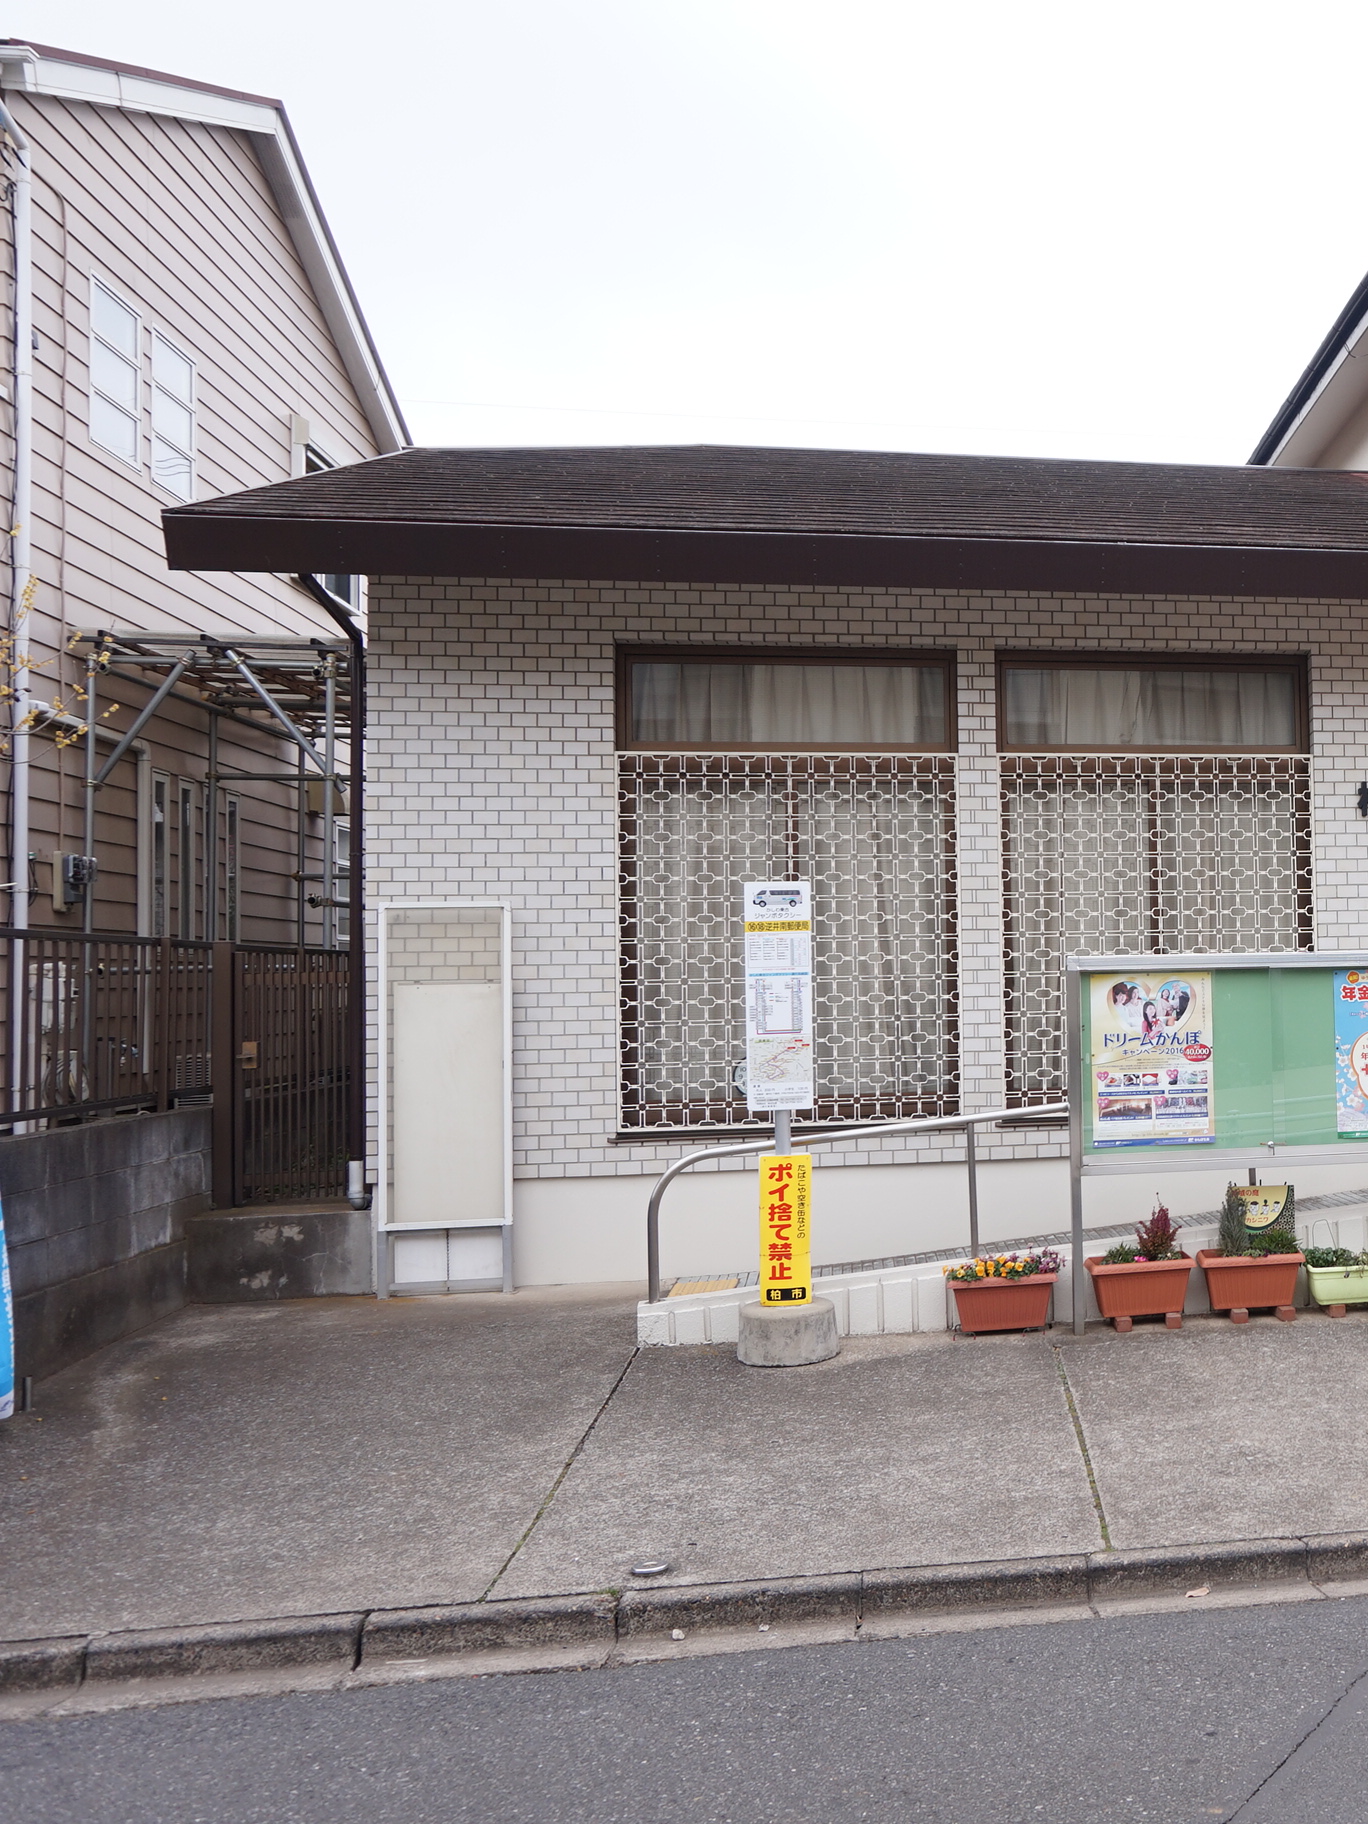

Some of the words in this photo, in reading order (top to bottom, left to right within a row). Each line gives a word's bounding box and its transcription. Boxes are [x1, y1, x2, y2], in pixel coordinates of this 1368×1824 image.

[1104, 1030, 1202, 1048] ドリームかんぽ
[1361, 1052, 1368, 1060] 年
[768, 1162, 793, 1280] ポイ捨て禁止
[797, 1164, 806, 1239] たばこや空き缶などの
